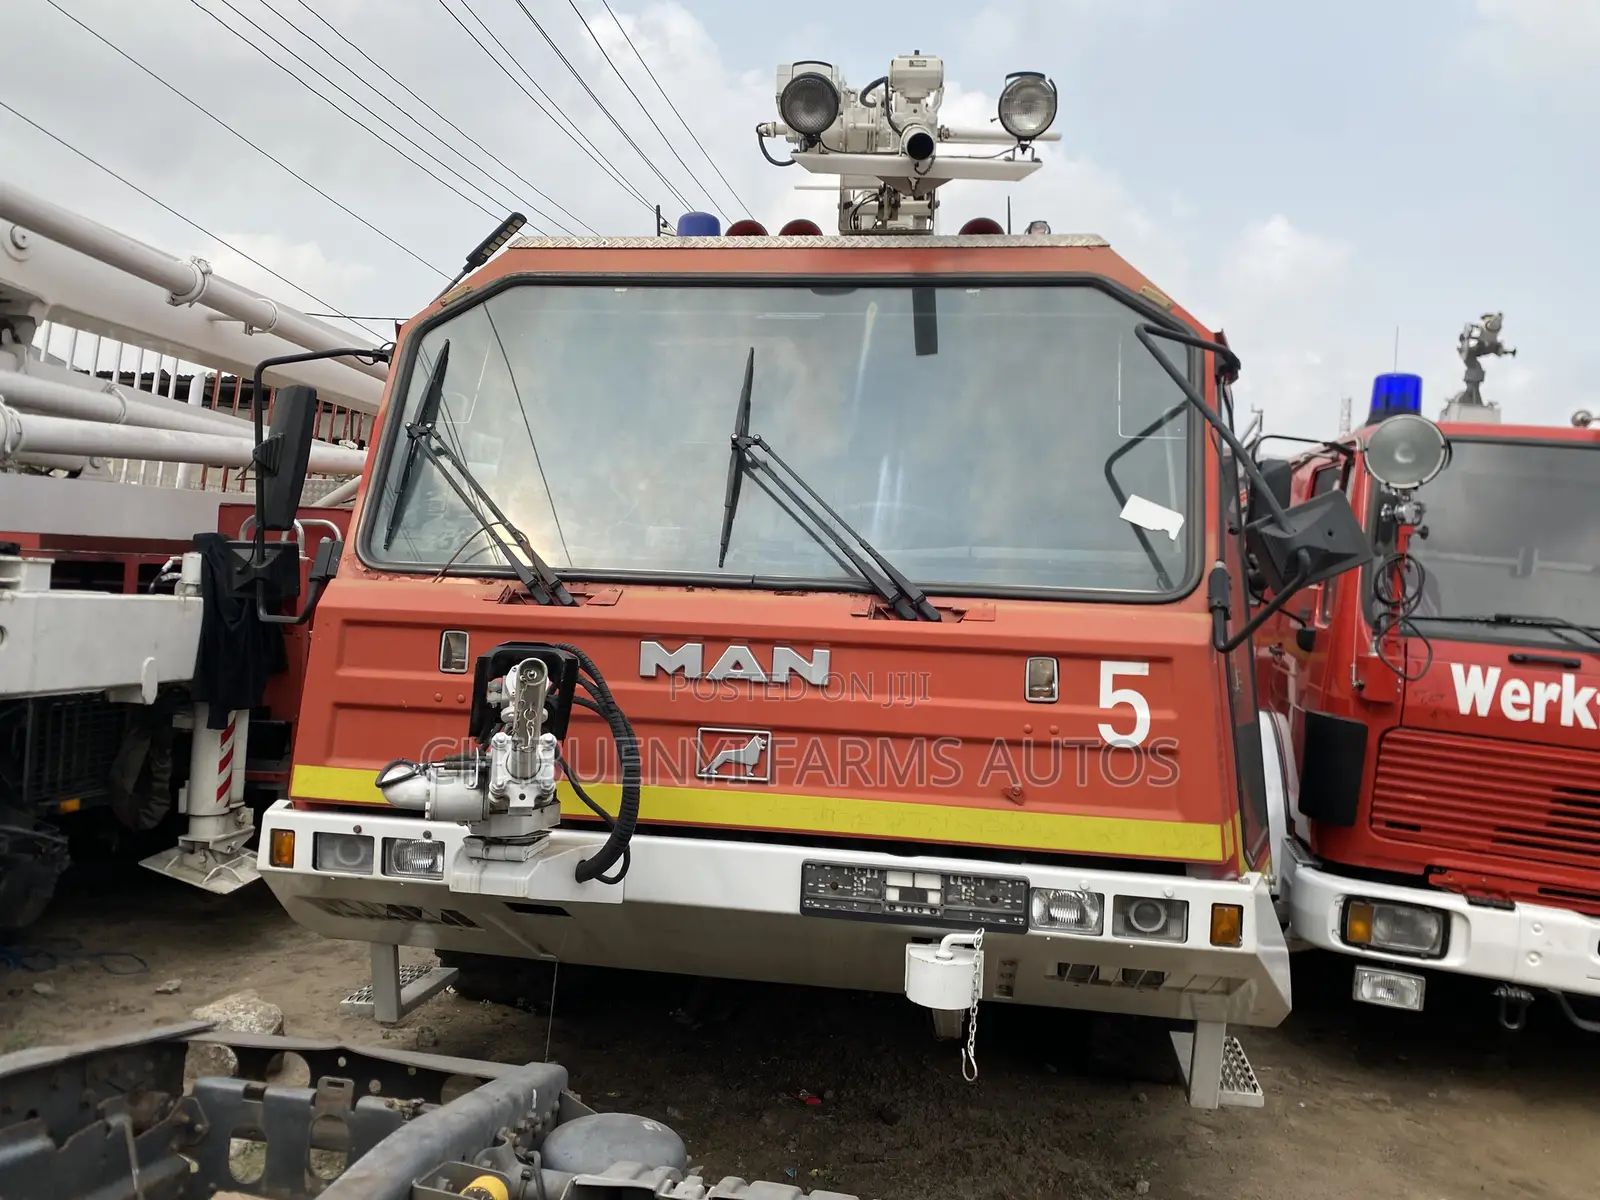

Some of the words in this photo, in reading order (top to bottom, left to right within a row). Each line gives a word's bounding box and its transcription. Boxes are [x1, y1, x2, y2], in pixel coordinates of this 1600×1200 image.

[639, 640, 831, 687] MAN
[1450, 662, 1600, 730] Werk
[1098, 660, 1151, 749] 5
